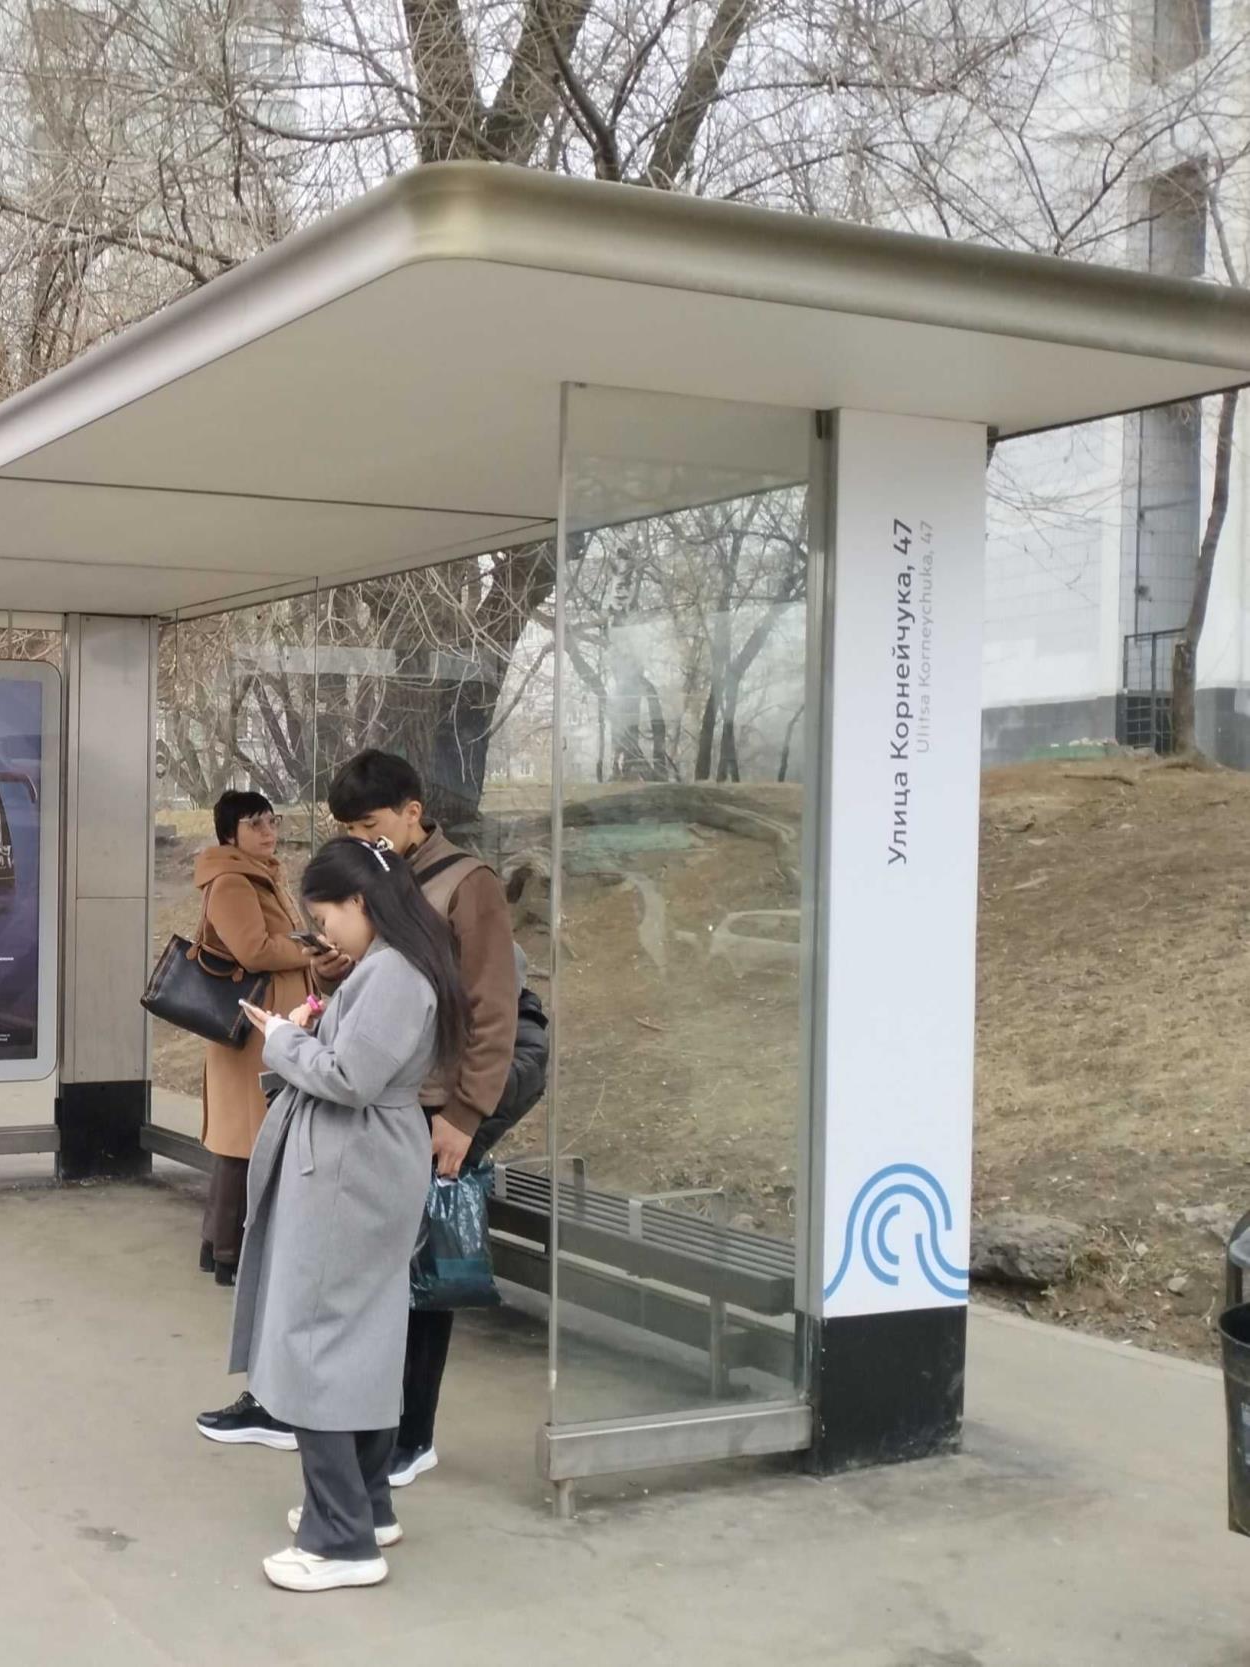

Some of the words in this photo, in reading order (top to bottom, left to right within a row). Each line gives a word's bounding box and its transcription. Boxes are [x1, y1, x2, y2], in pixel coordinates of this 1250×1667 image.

[893, 518, 912, 556] 47
[920, 520, 933, 544] 47
[918, 550, 935, 687] Korneychuka,
[890, 565, 916, 760] Корнейчука,
[916, 694, 931, 753] Ulitsa
[888, 772, 910, 865] Улица
